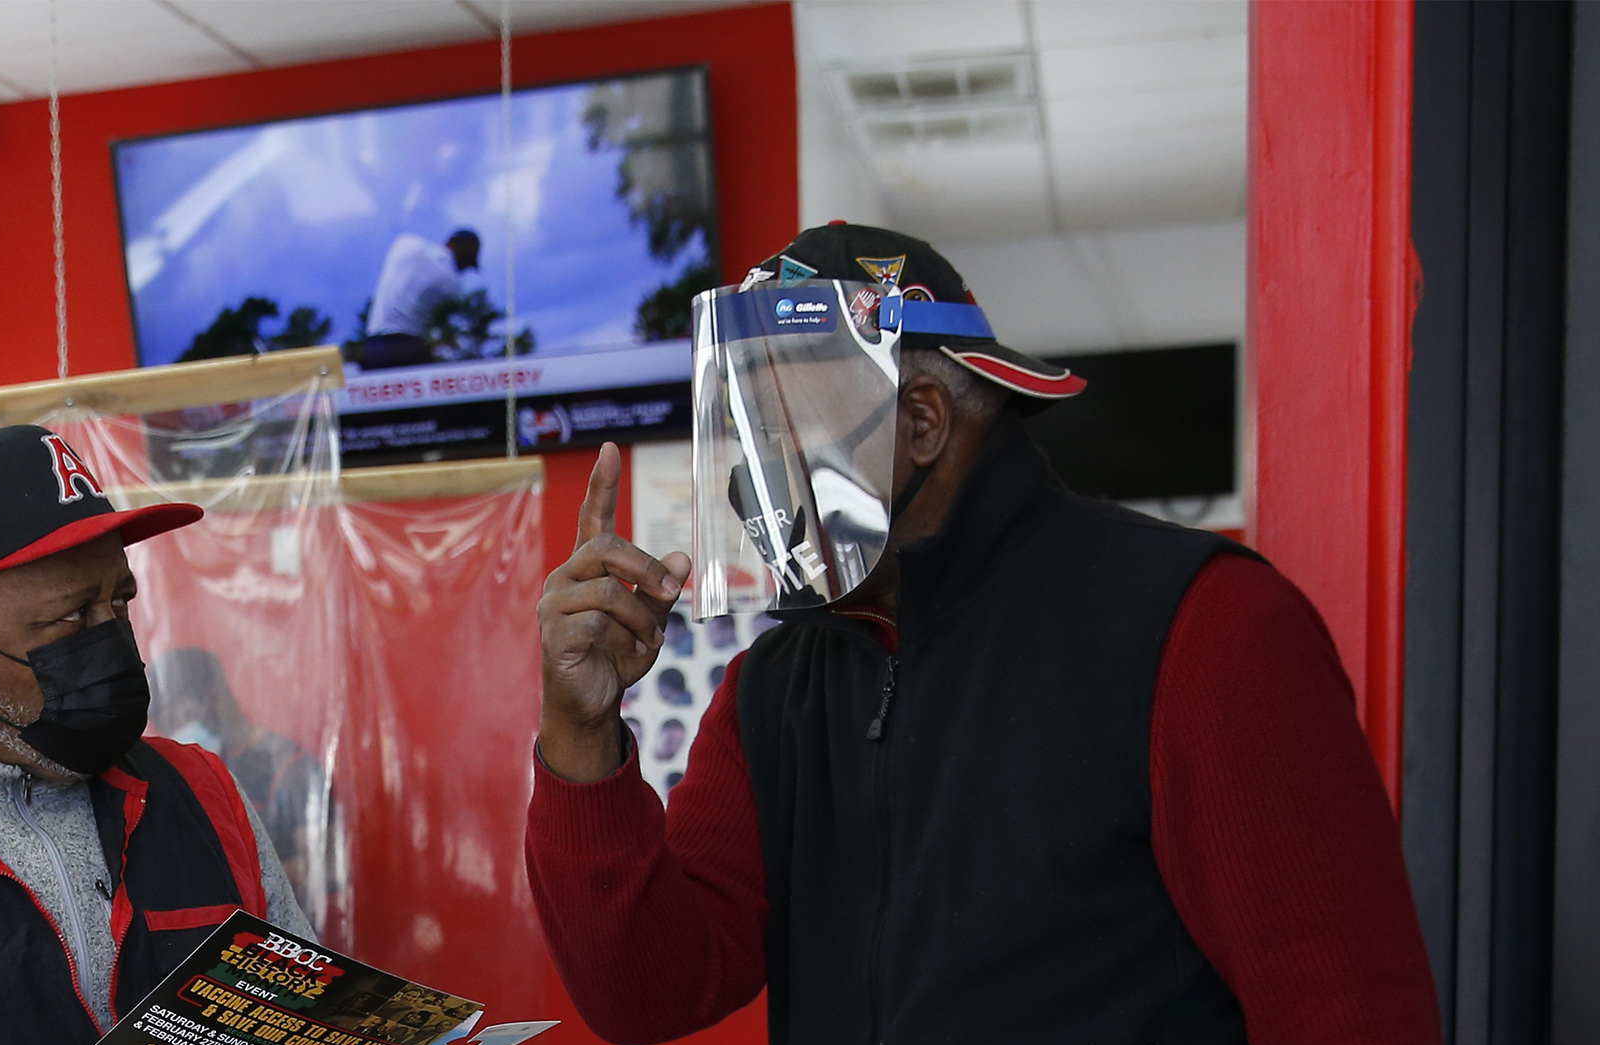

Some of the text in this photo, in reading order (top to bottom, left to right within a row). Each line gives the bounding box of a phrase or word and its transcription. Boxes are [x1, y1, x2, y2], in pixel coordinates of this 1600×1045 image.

[795, 302, 828, 313] Gillette
[347, 370, 544, 401] TIGER'S RECOVERY
[40, 433, 106, 504] A
[226, 952, 318, 994] HISTORY
[235, 980, 278, 1001] EVENT
[133, 1020, 143, 1030] &
[149, 1004, 210, 1034] SATURDAY
[207, 1029, 217, 1038] &
[190, 979, 252, 1013] VACCINE
[248, 1005, 305, 1033] ACCESS
[307, 1024, 327, 1040] TO
[201, 1003, 218, 1018] &
[217, 1009, 258, 1033] SAVE
[253, 1024, 289, 1044] OUR
[141, 1012, 202, 1043] FEBRUARY
